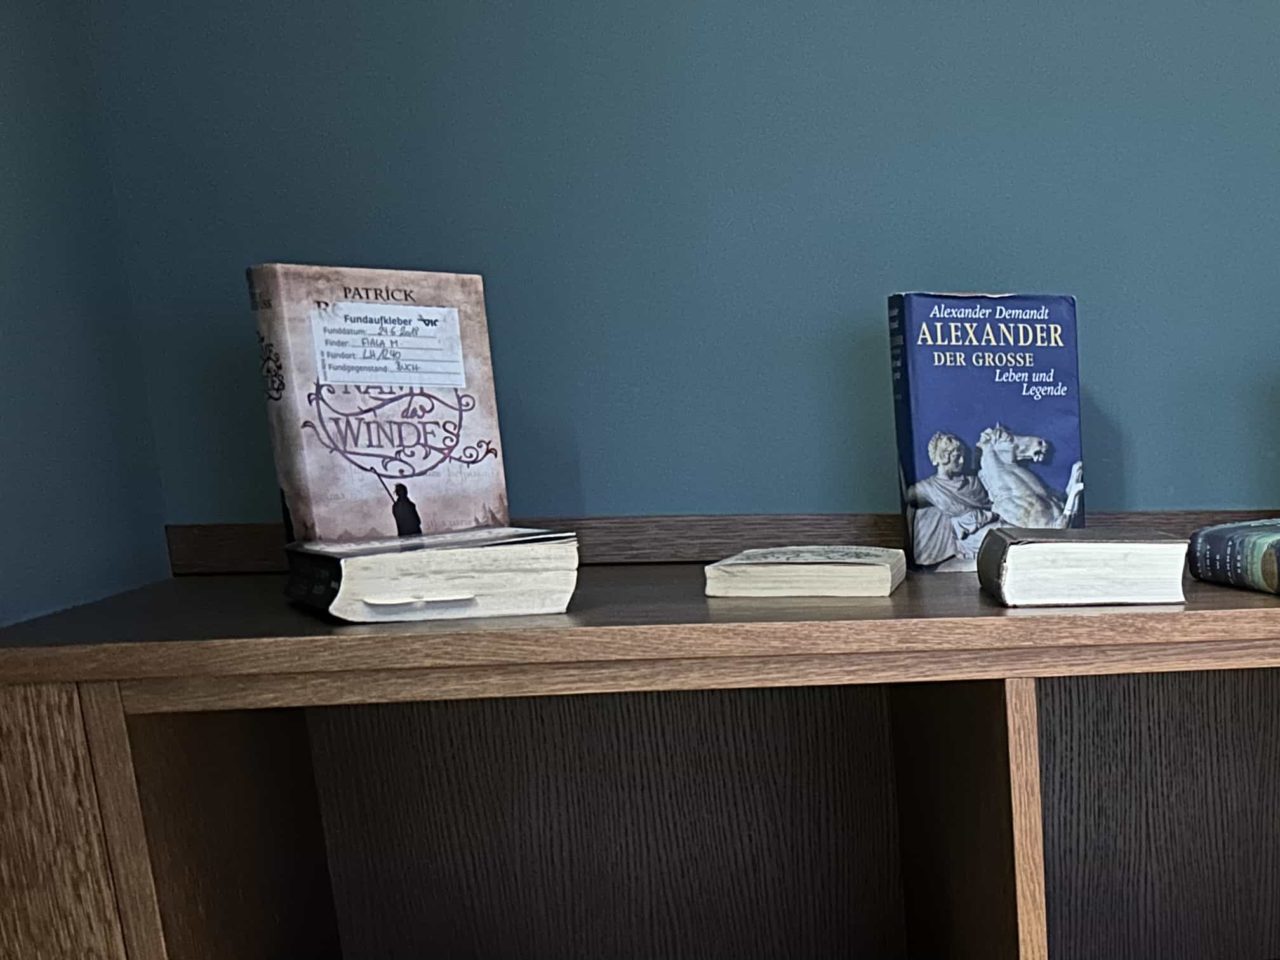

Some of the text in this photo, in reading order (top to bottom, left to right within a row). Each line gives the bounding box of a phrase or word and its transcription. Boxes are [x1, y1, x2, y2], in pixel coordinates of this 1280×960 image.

[343, 286, 416, 302] PATRICK
[930, 304, 1049, 320] Alexander Demandt
[344, 314, 412, 327] Fundaufkleber
[916, 322, 1064, 347] ALEXANDER
[933, 352, 1034, 367] DER GROSSE
[994, 369, 1054, 383] Leben und
[1022, 383, 1067, 399] Legende
[329, 416, 459, 450] WINDES
